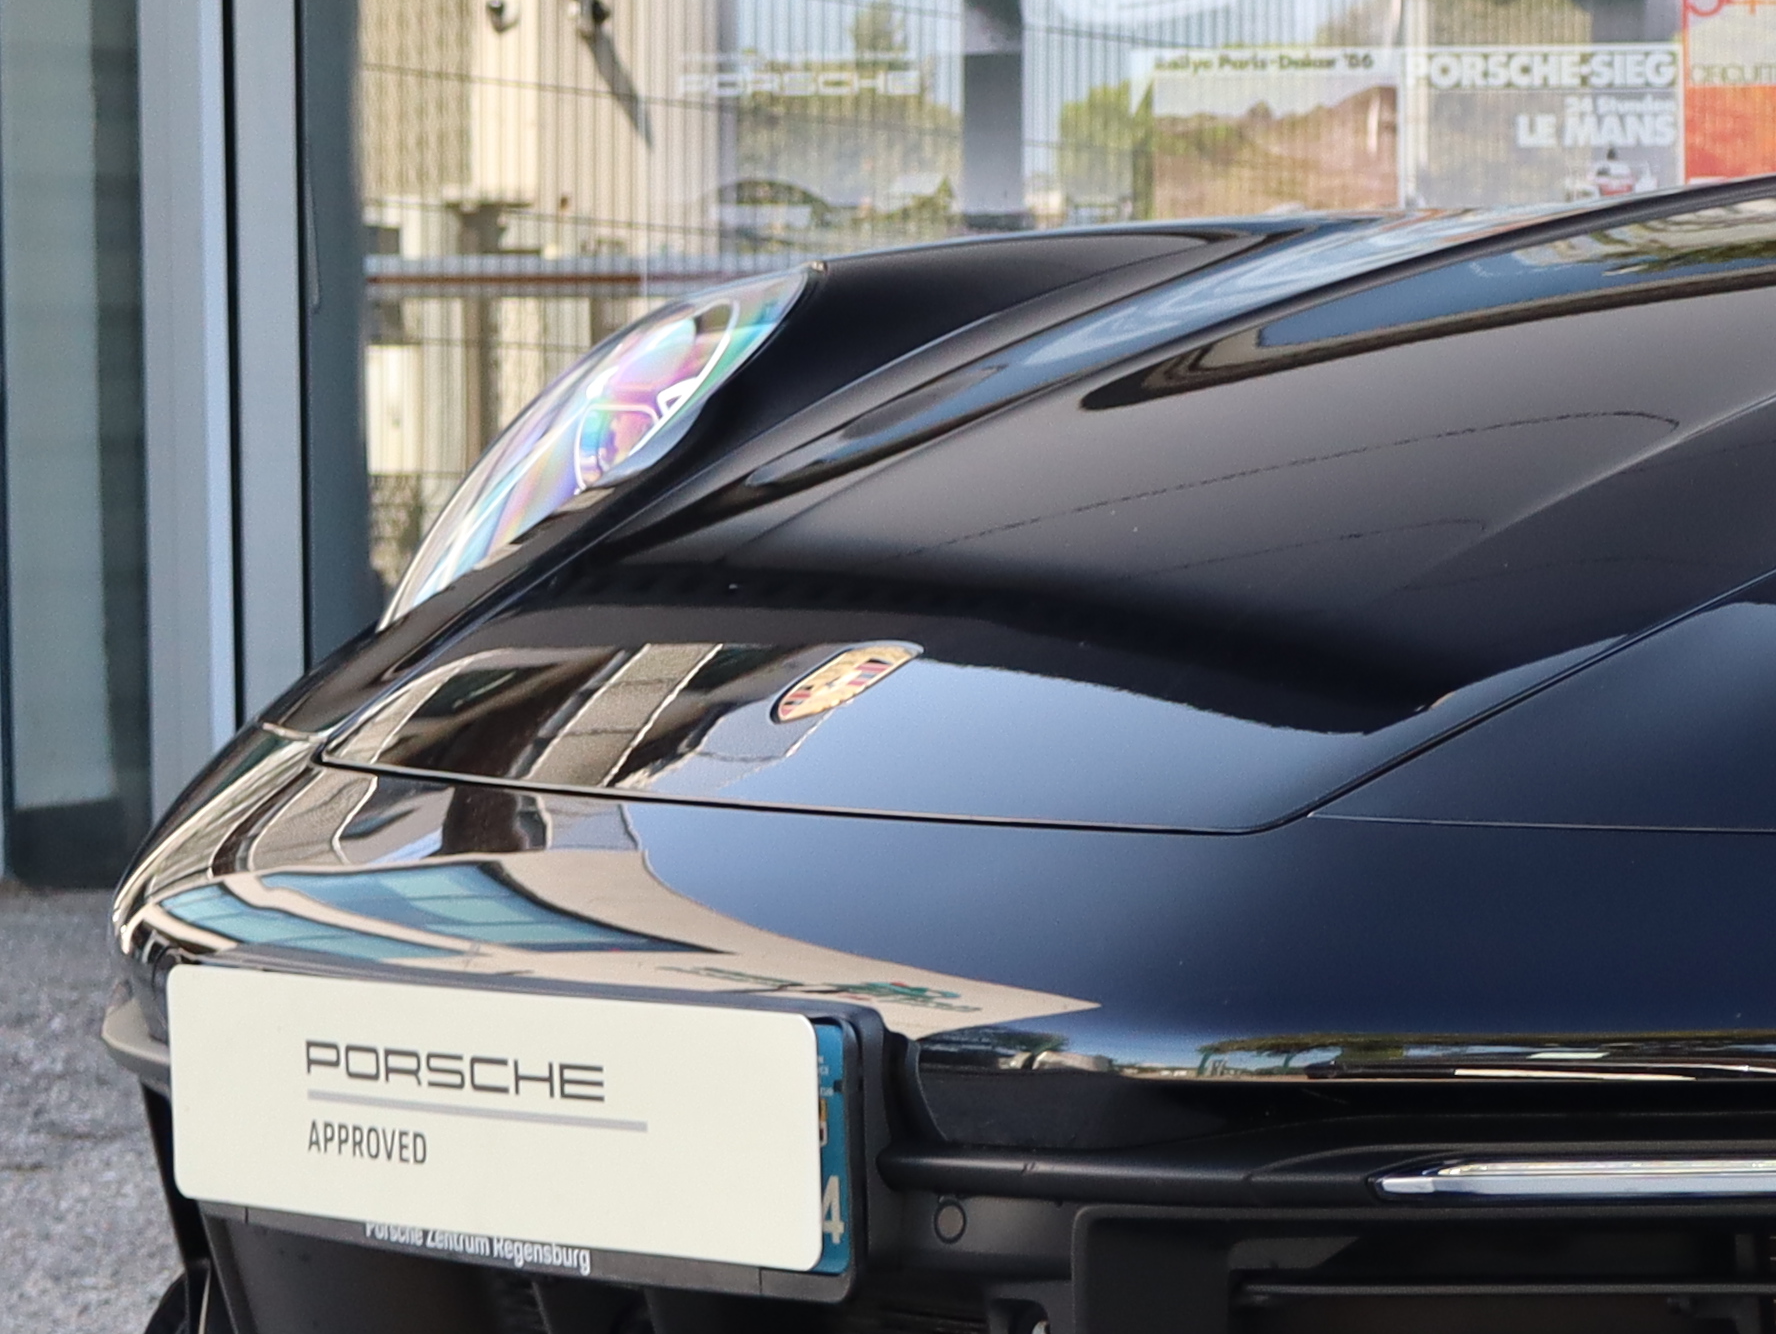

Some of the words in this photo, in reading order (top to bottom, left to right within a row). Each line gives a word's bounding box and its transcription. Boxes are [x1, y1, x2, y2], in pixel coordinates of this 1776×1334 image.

[678, 70, 921, 97] PORSCHE
[1516, 113, 1557, 148] LE
[1563, 113, 1676, 148] MANS
[306, 1039, 605, 1102] PORSCHE
[308, 1119, 427, 1165] APPROVED
[365, 1222, 424, 1248] Porsche
[426, 1228, 491, 1258] Zentrum
[493, 1235, 591, 1277] Regensburg
